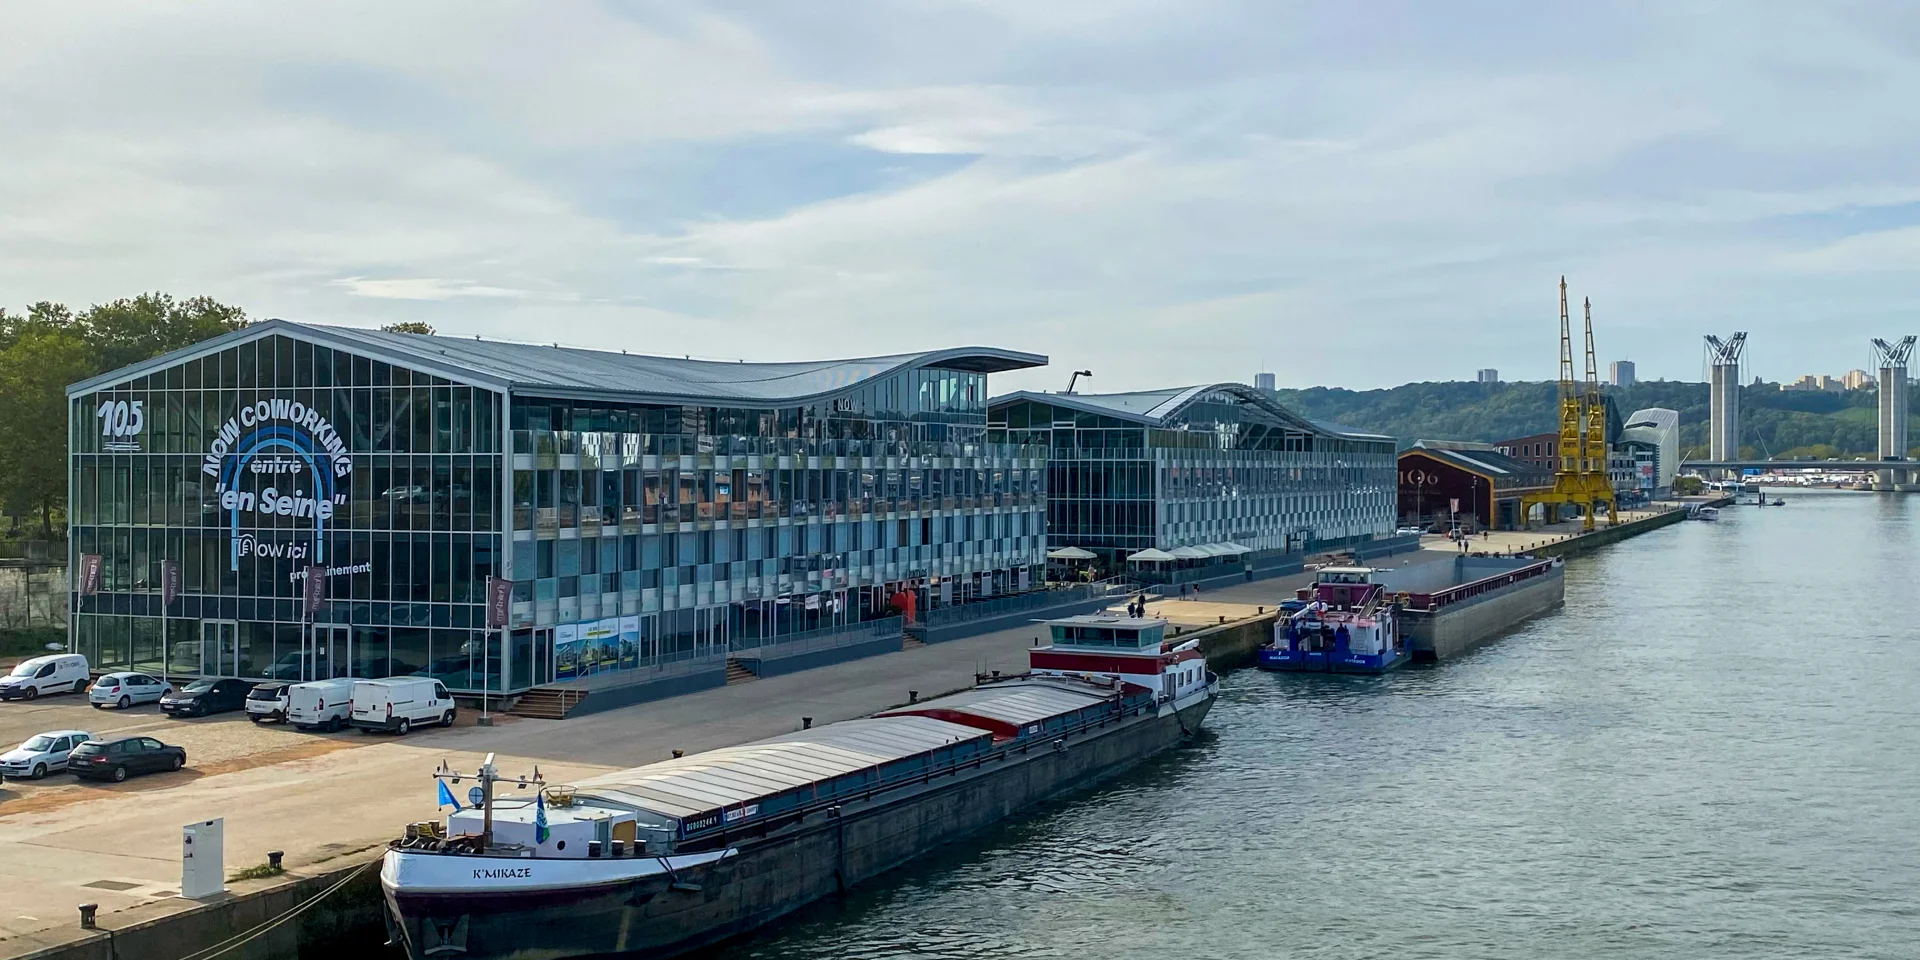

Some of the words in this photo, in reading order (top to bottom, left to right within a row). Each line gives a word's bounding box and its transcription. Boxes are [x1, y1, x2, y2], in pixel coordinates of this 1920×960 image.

[838, 398, 858, 412] NOW
[97, 400, 143, 437] 105
[203, 417, 241, 477] NOW
[240, 399, 352, 478] COWORKING
[251, 457, 301, 474] entre
[1399, 469, 1439, 485] 106
[287, 542, 307, 558] ici
[290, 562, 371, 583] proinement
[473, 868, 531, 879] K'MIKAZE
